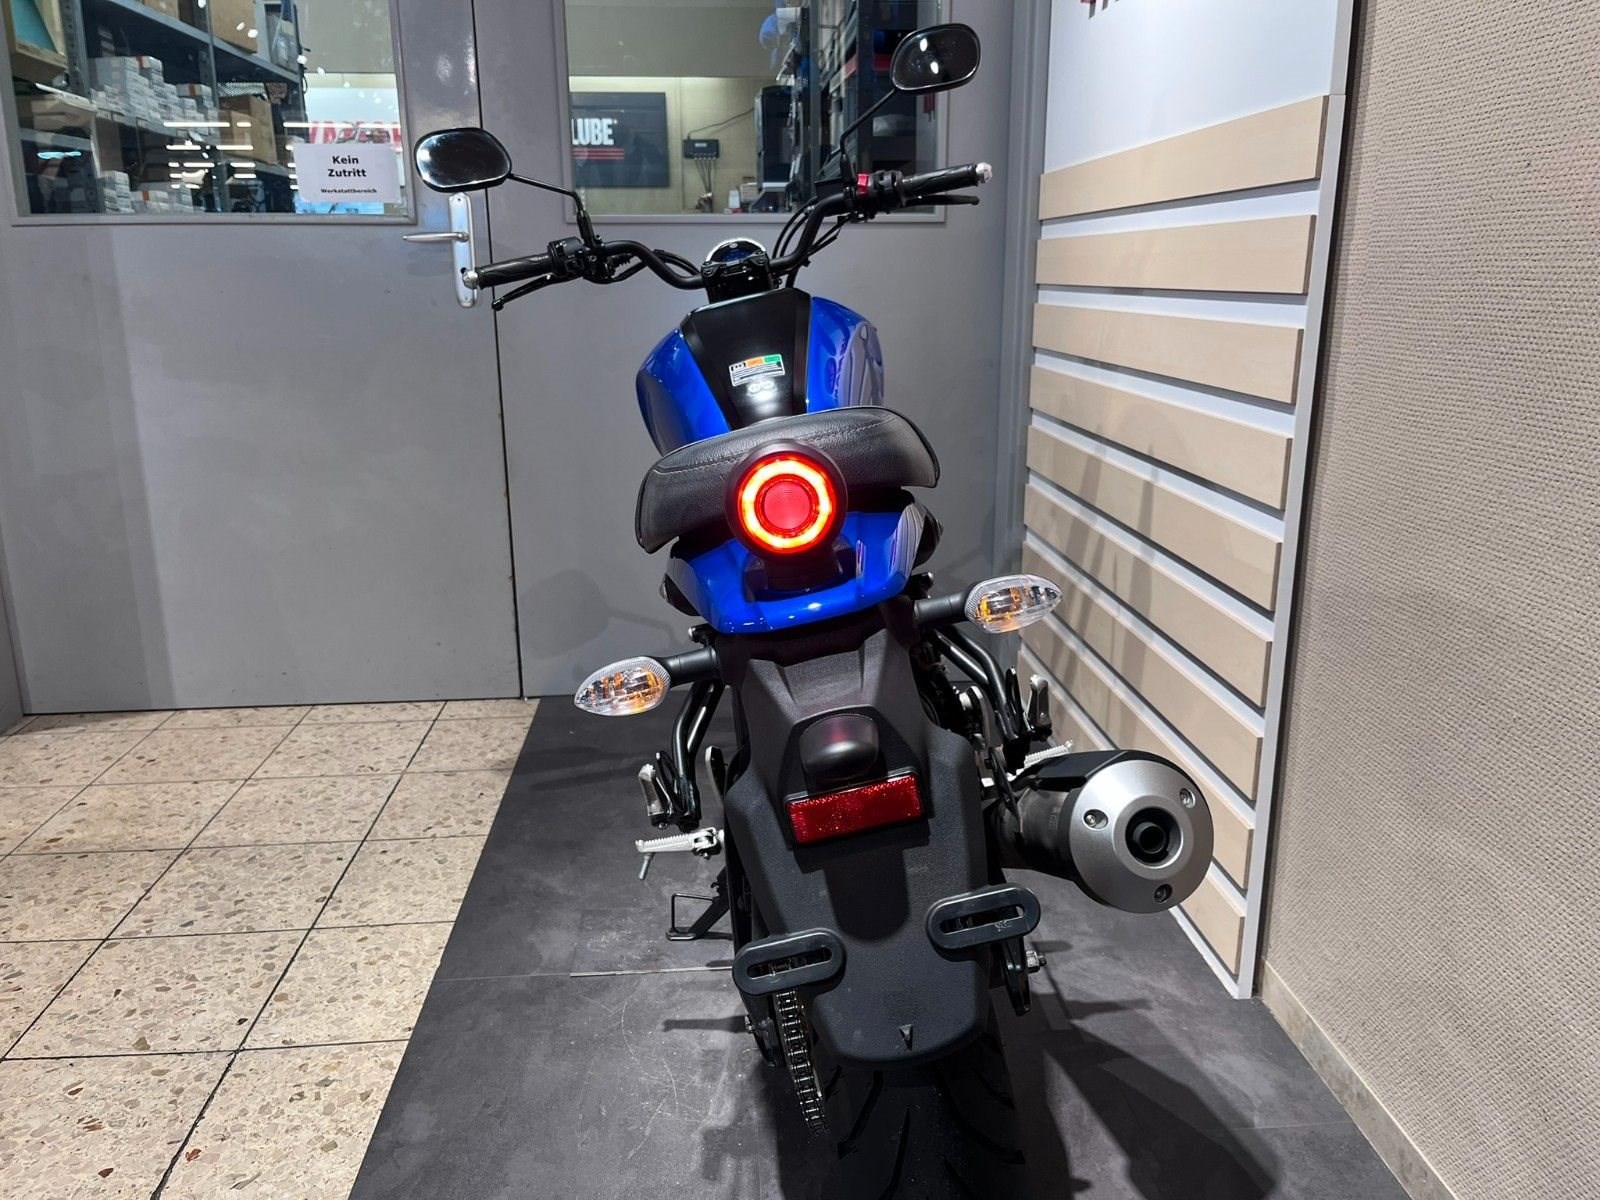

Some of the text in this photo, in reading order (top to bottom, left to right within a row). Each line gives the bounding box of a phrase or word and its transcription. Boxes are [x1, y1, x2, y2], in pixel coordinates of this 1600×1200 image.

[571, 118, 615, 145] LUBE
[332, 155, 359, 165] Kein
[328, 168, 367, 178] Zutritt
